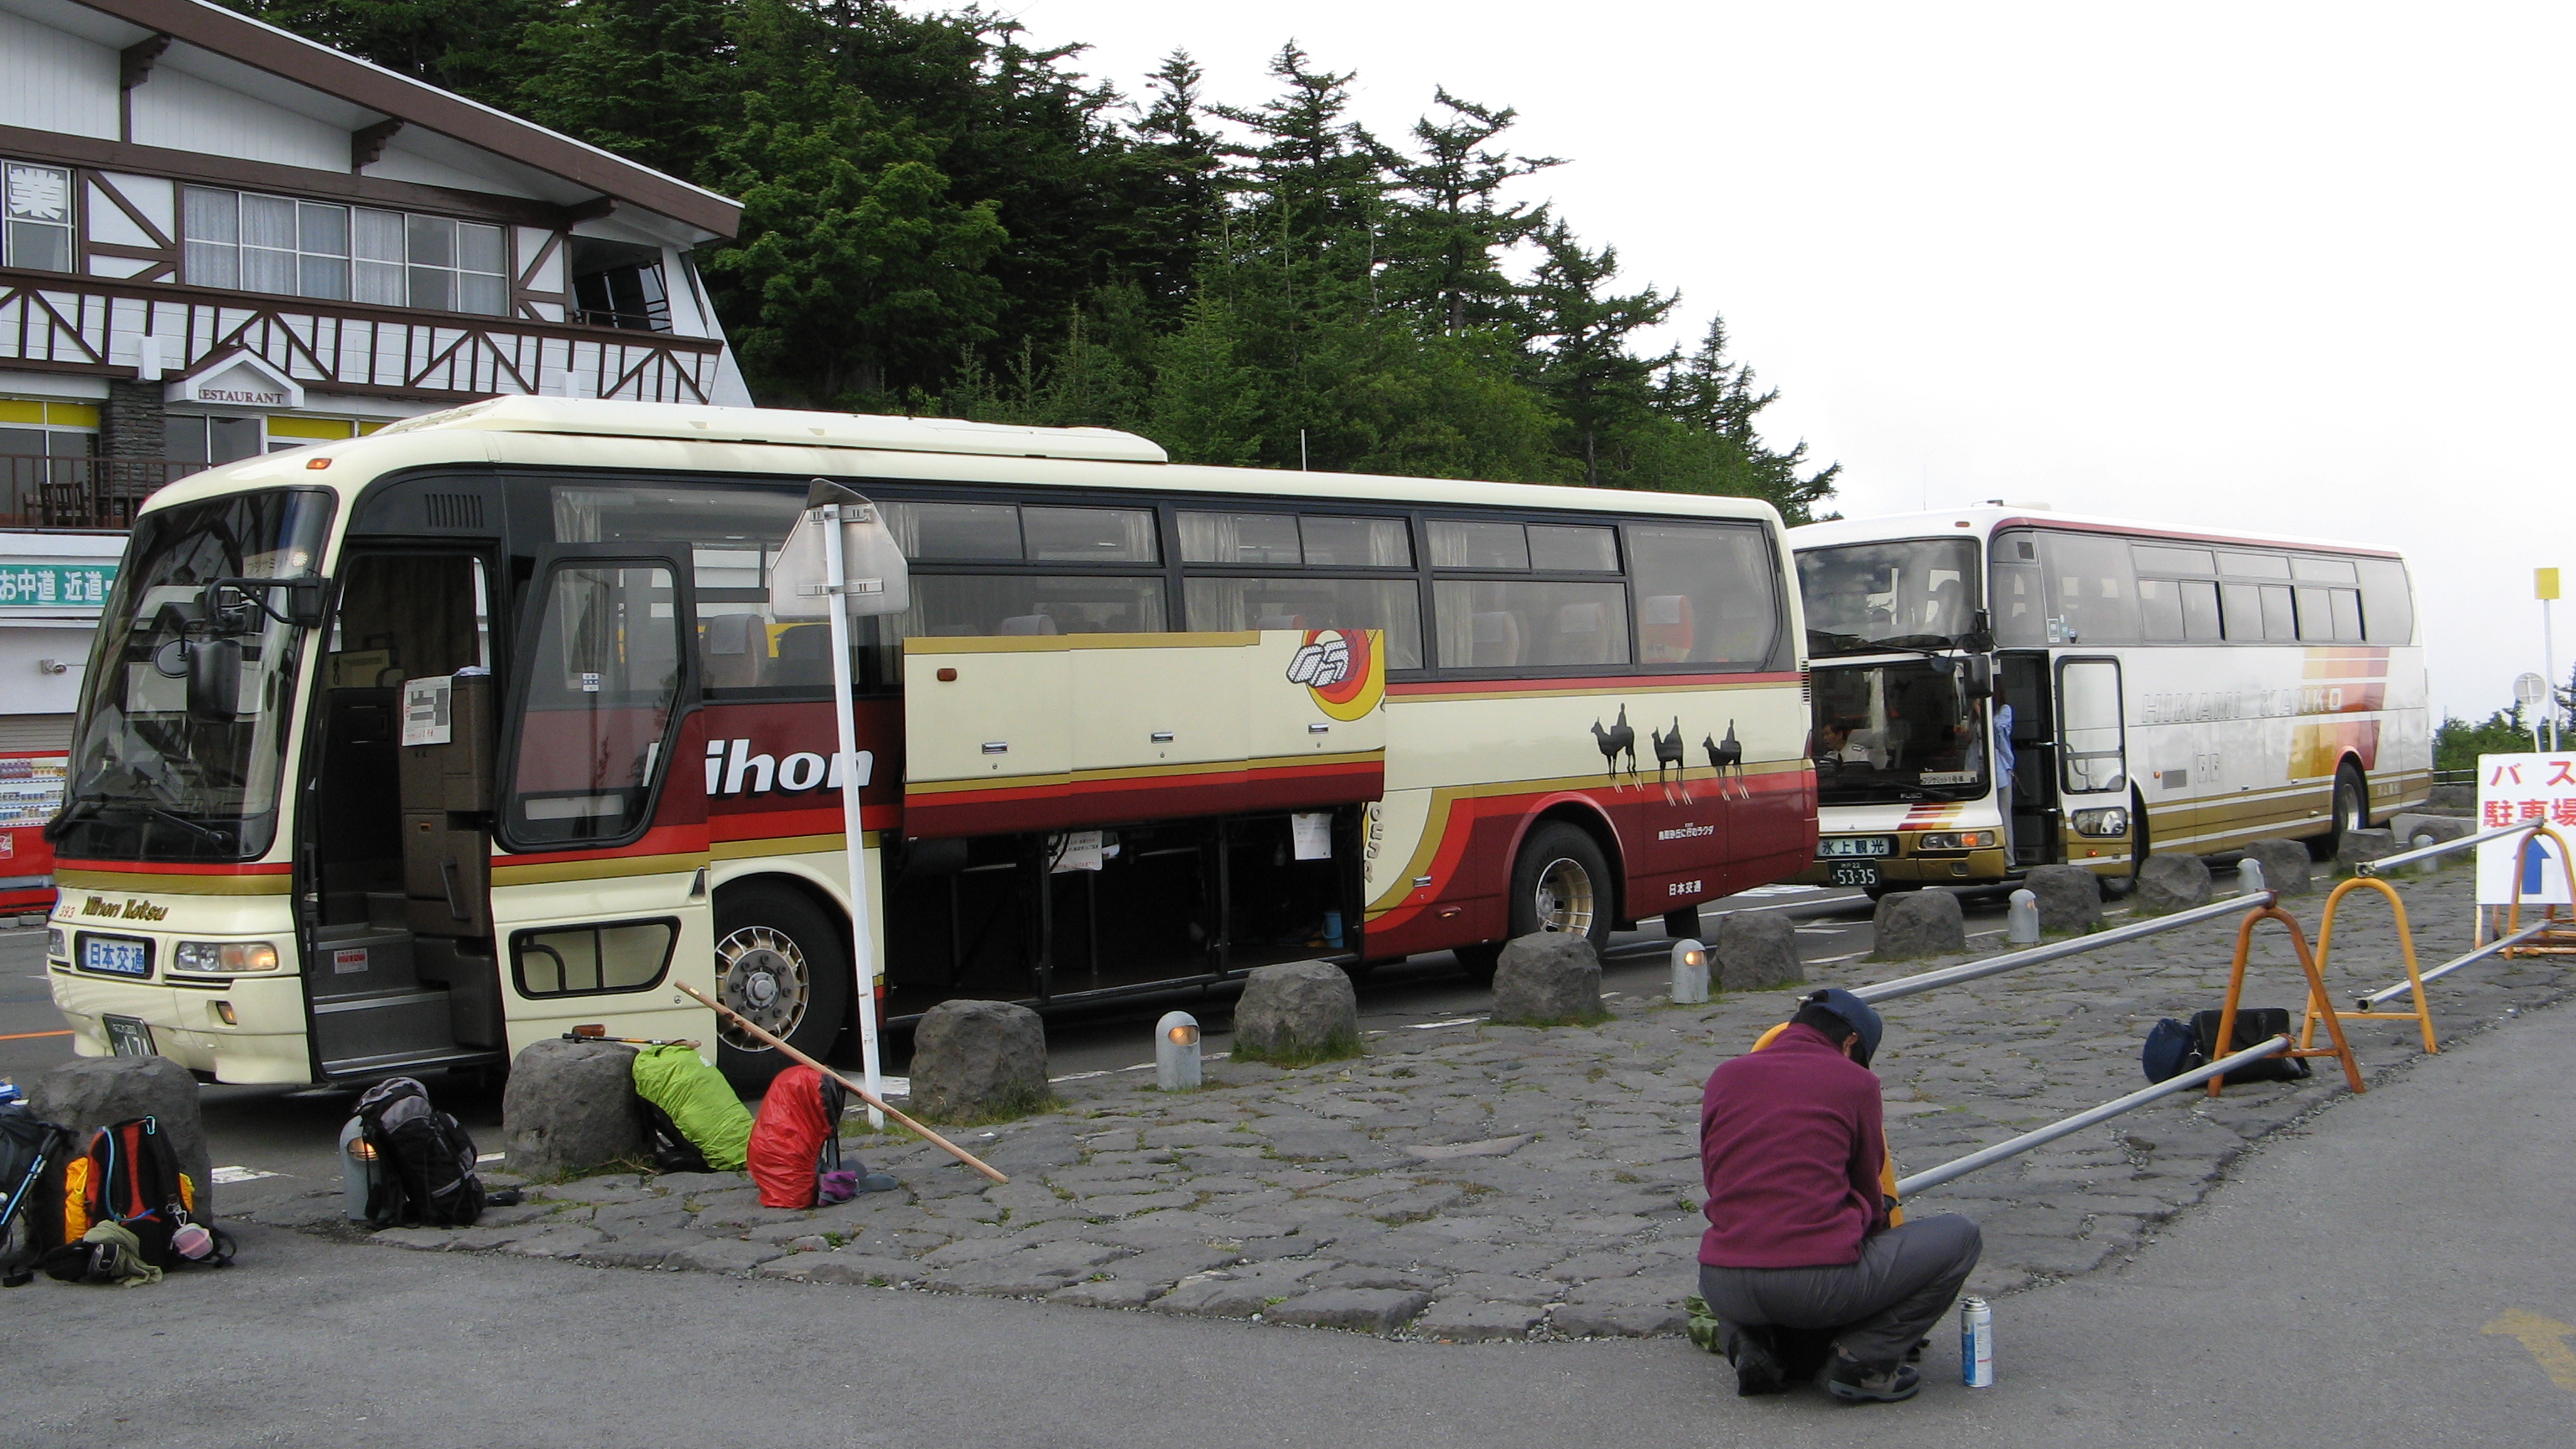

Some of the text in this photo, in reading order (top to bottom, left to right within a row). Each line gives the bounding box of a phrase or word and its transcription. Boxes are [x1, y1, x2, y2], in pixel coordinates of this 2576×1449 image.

[9, 168, 66, 220] 業
[0, 569, 102, 600] お中道 近道
[2142, 687, 2342, 723] HIKAMI KANKO
[2489, 762, 2576, 787] バス
[2483, 798, 2576, 828] 駐車場
[1822, 839, 1884, 854] 氷上観光
[1669, 880, 1701, 896] 日本交通
[1837, 869, 1876, 885] 53-35
[59, 905, 75, 918] 393
[82, 896, 169, 921] Nihon Kotsu
[91, 943, 144, 973] 日本交通
